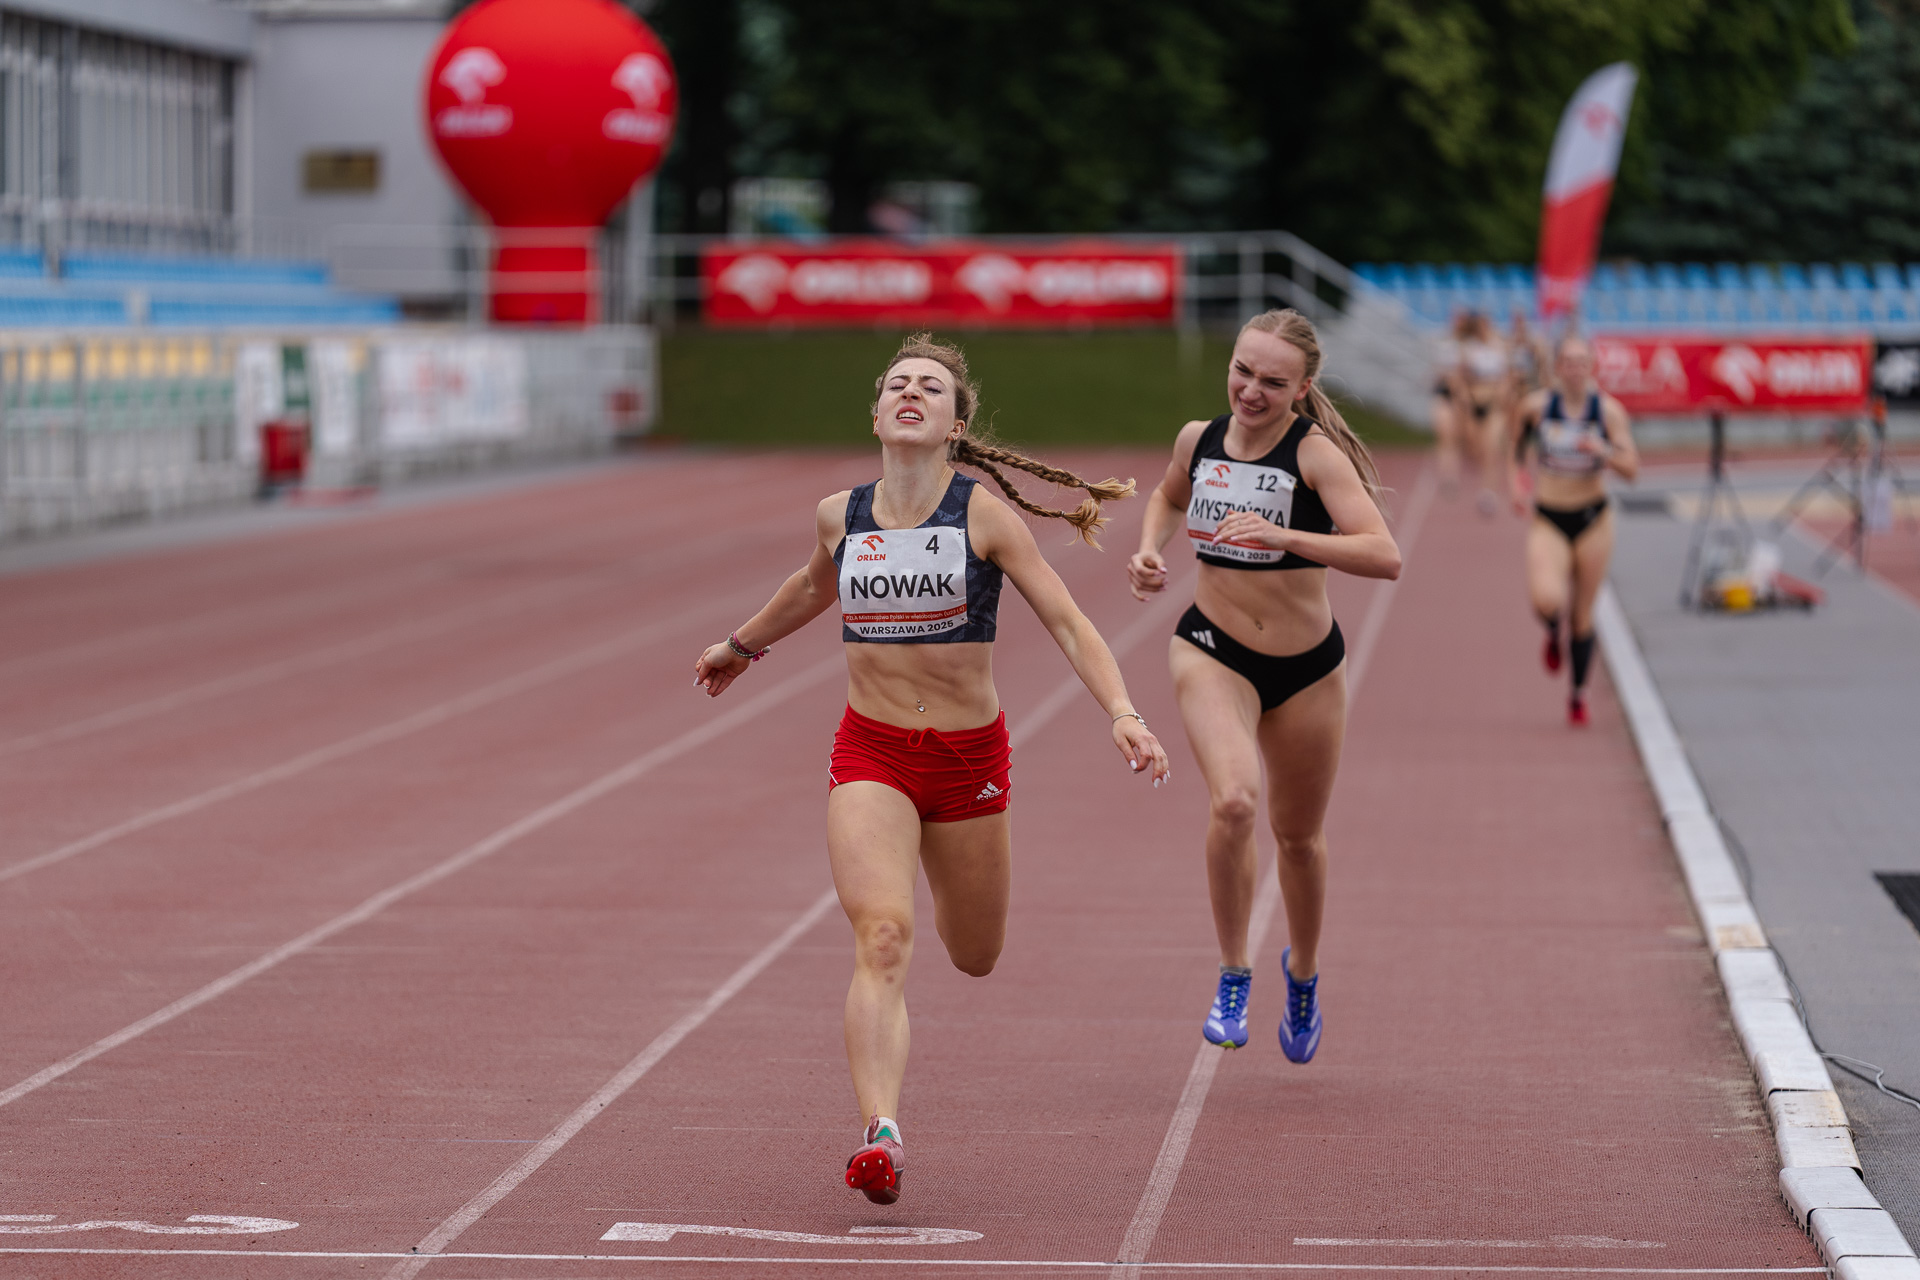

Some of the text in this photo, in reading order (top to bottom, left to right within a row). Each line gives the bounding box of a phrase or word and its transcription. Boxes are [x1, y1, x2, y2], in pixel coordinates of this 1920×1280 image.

[1205, 479, 1229, 489] ORLEN
[1255, 473, 1278, 493] 12
[925, 534, 940, 555] 4
[1199, 542, 1245, 559] WARSZAWA
[1246, 551, 1271, 560] 2025
[857, 553, 886, 562] ORLEN
[850, 573, 956, 600] NOWAK
[860, 620, 954, 635] WARSZAWA 2025
